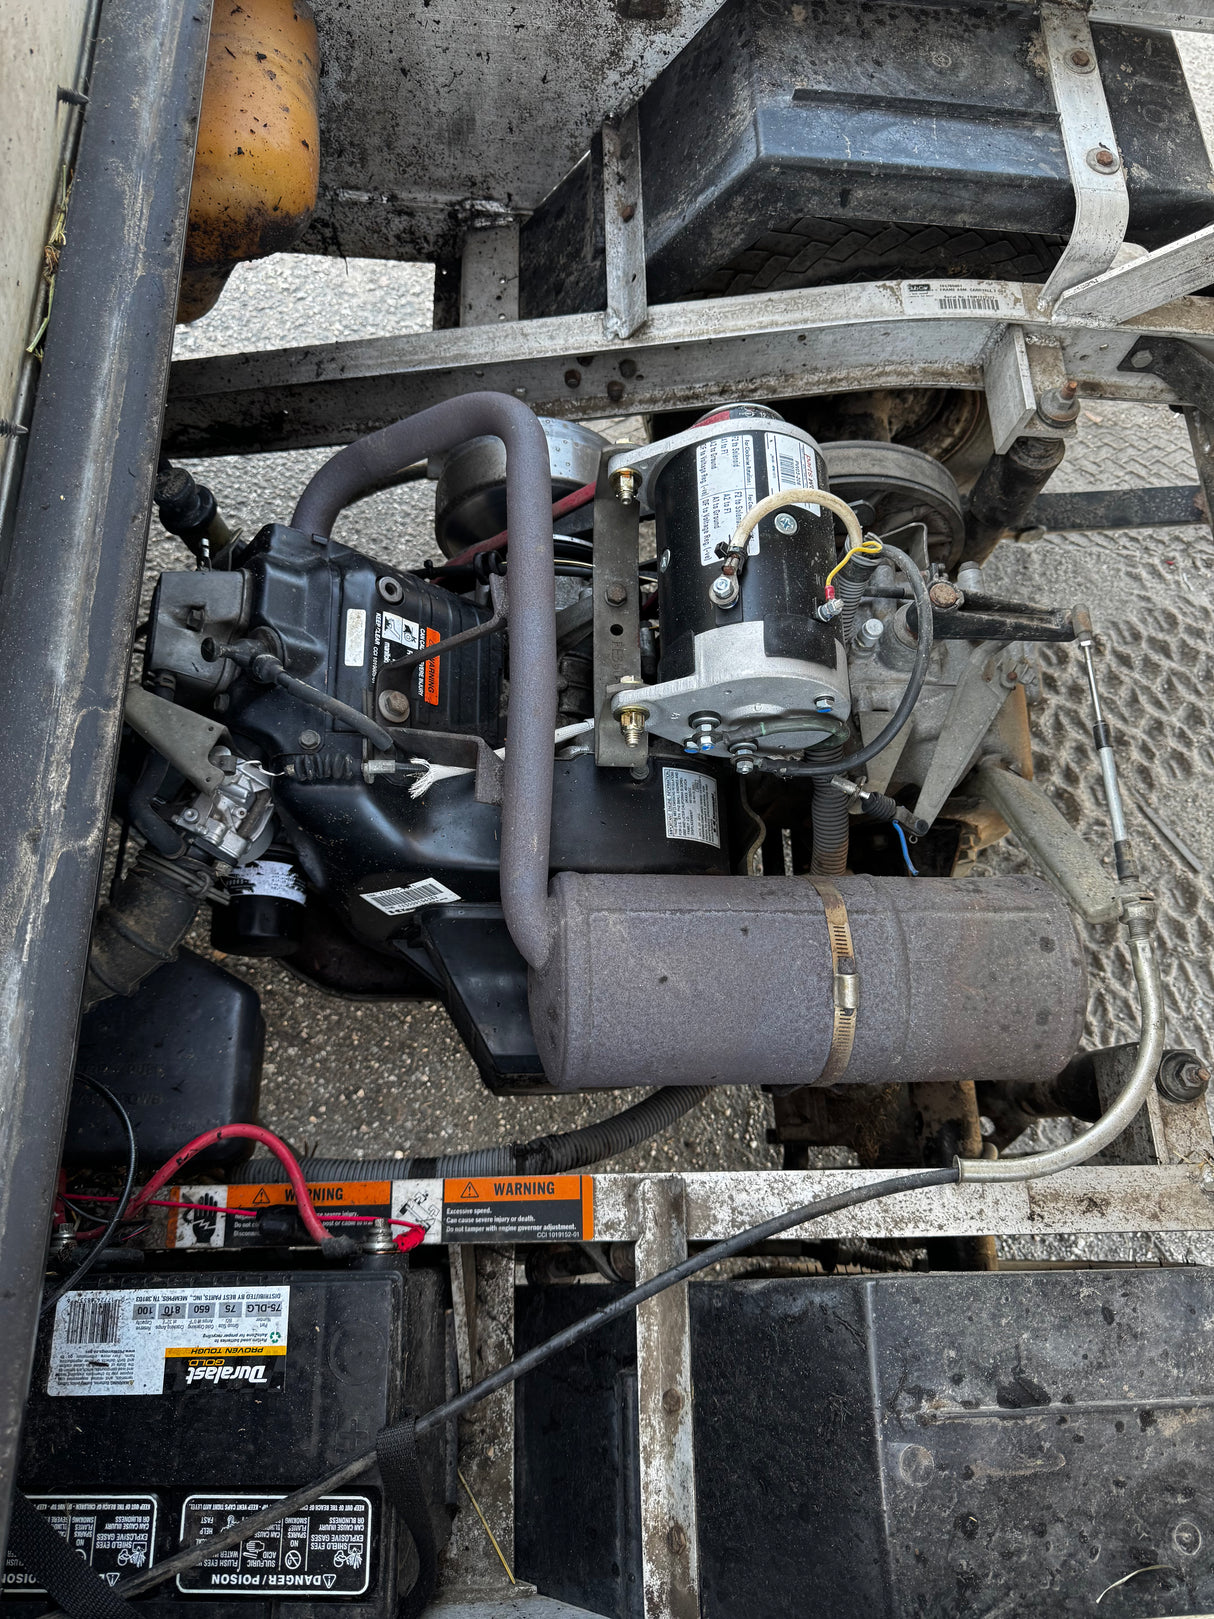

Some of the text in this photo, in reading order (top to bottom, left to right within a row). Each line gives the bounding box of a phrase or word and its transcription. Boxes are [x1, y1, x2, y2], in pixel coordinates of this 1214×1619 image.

[702, 513, 710, 534] Voltage
[494, 1181, 555, 1196] WARNING
[138, 1304, 282, 1314] 75-DLG 75 650 810 100
[185, 1365, 268, 1384] Duralast
